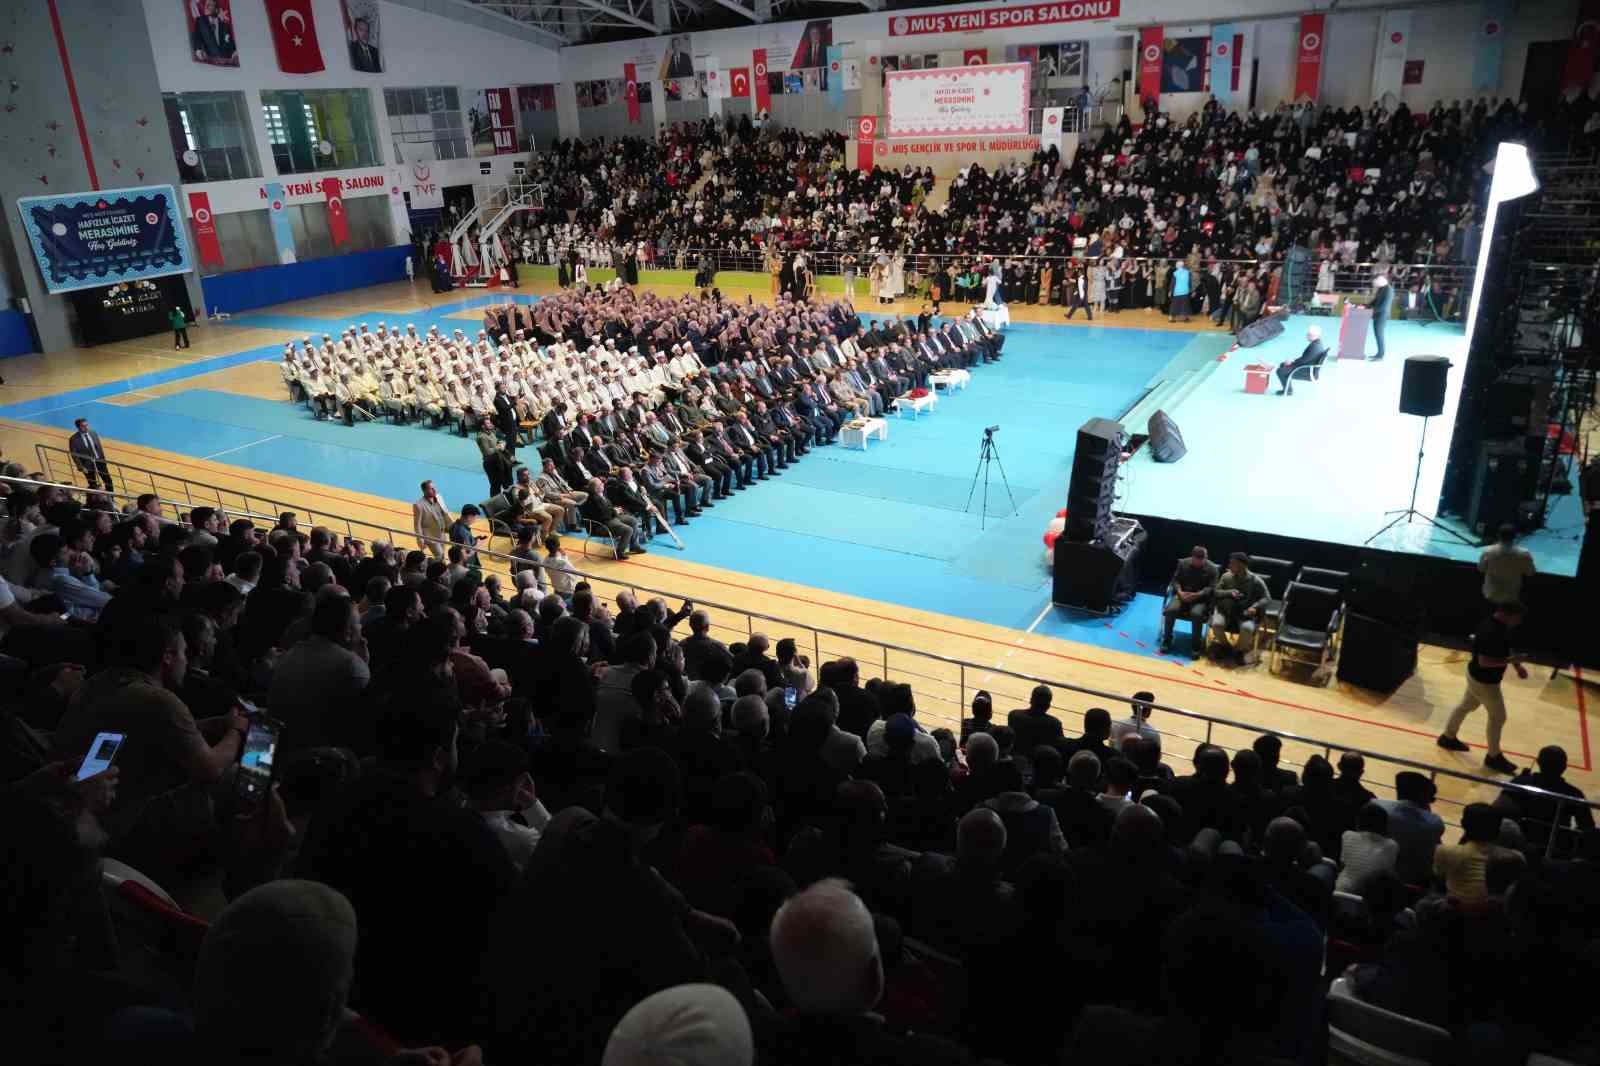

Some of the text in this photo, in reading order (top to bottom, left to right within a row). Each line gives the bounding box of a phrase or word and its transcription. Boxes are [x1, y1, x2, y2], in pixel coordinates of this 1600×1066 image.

[911, 1, 1112, 32] MUŞ YENİ SPOR SALONU
[892, 144, 908, 155] MUŞ
[911, 141, 941, 154] GENÇLİK
[944, 143, 953, 153] VE
[957, 142, 976, 152] SPOR
[286, 180, 313, 197] YENİ
[345, 175, 385, 190] SALONU
[78, 224, 140, 240] MERASİMİNE
